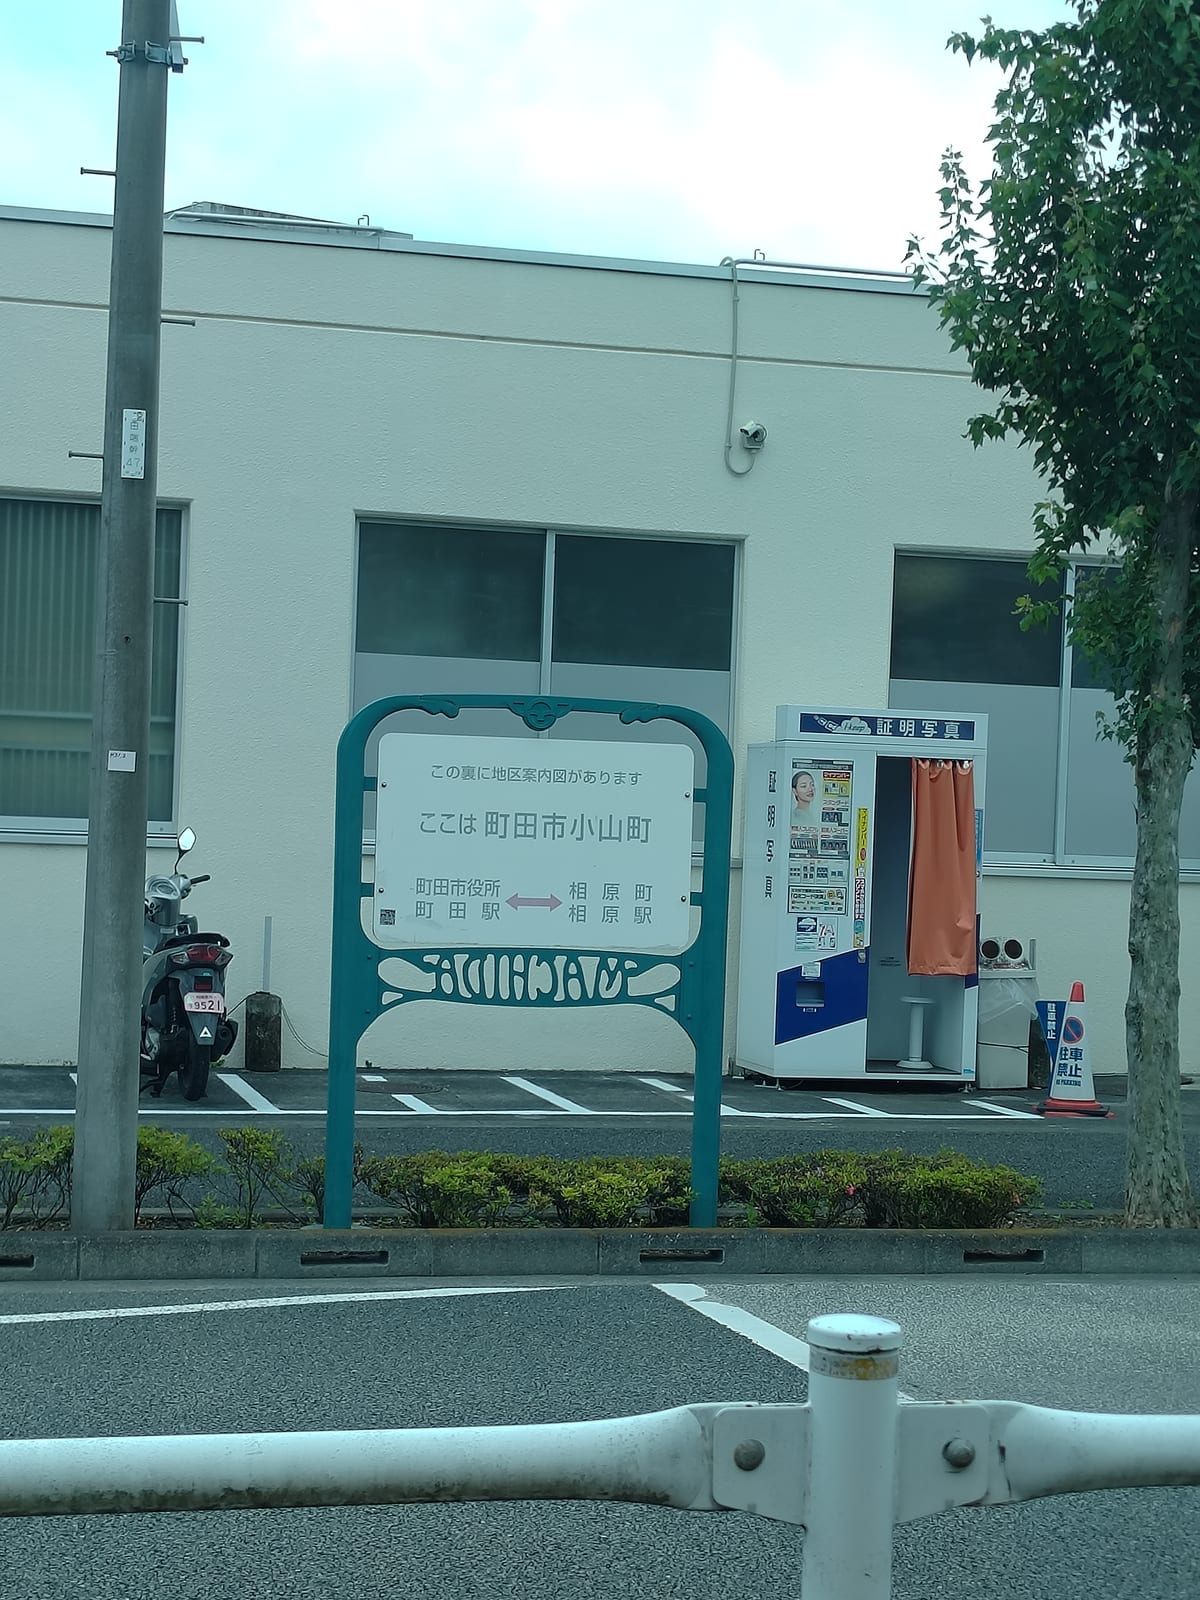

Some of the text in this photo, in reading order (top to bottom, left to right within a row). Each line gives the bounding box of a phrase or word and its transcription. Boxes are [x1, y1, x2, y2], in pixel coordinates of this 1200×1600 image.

[876, 718, 961, 739] 証明写真
[430, 764, 642, 786] この裏に地区案内図があります
[415, 878, 501, 898] 町田市役所
[568, 882, 653, 902] 相原町
[415, 902, 501, 921] 町田駅
[568, 905, 653, 925] 相原駅
[195, 1000, 219, 1011] 9521
[1060, 1047, 1083, 1061] 駐車
